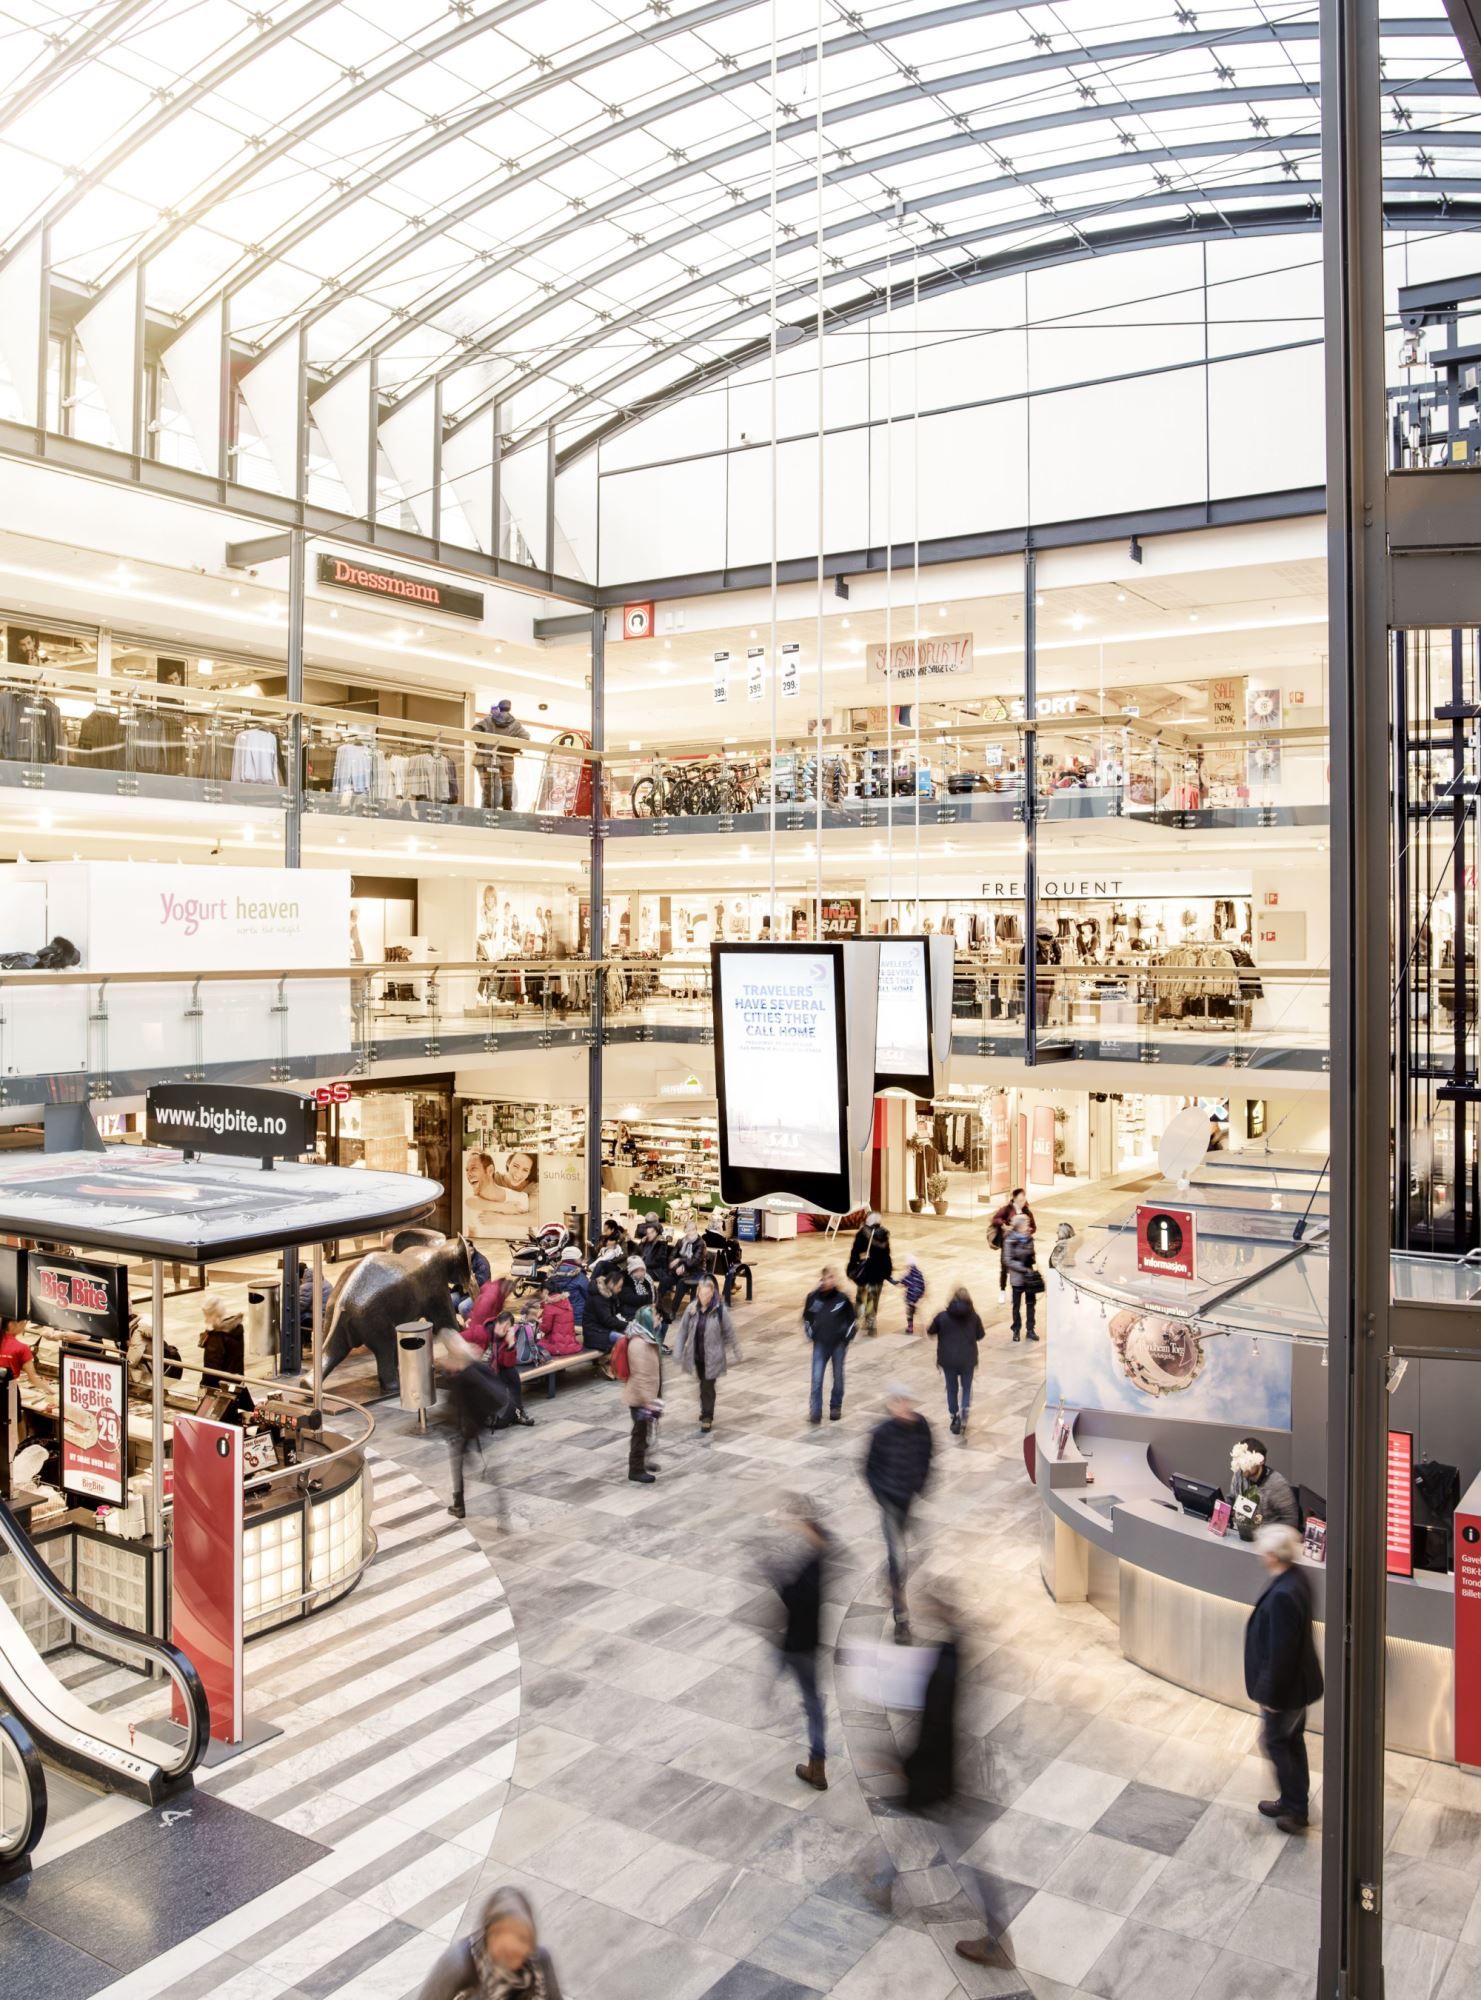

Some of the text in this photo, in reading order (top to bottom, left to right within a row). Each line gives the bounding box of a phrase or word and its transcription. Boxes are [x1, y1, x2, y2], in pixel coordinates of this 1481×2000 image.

[334, 560, 440, 604] Dressmann
[1010, 696, 1080, 719] SORT
[160, 892, 300, 936] Yogurt heaven
[821, 906, 859, 919] INAL
[821, 919, 857, 932] SALE
[742, 984, 814, 997] TRAVELERS
[734, 998, 826, 1011] HAVE SEVERAL
[743, 1011, 818, 1025] CITIES THEY
[745, 1024, 816, 1038] CALL HOME
[309, 1083, 352, 1104] GS
[155, 1106, 287, 1135] www.bigbite.no
[543, 1168, 580, 1182] sunkost
[1143, 1256, 1188, 1273] Informasjon
[40, 1270, 108, 1311] Big Bite
[70, 1368, 112, 1391] DAGENS
[70, 1387, 113, 1409] BigBite
[98, 1417, 118, 1444] 29
